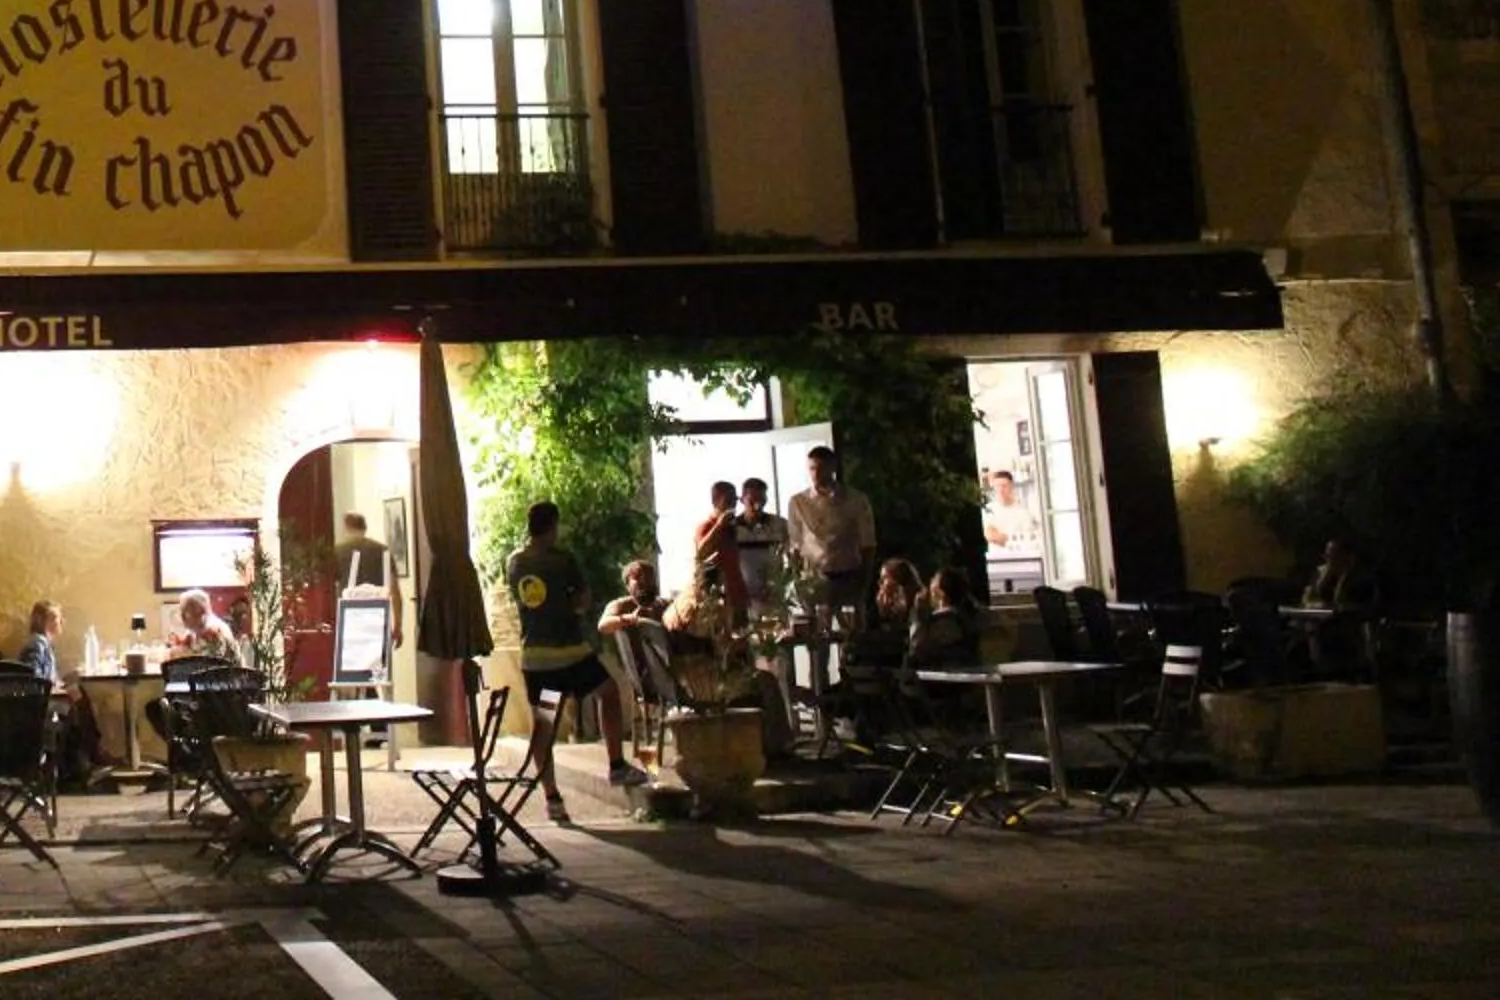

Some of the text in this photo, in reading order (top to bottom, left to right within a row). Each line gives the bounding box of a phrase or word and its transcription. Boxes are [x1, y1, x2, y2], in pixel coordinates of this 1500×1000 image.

[102, 58, 171, 118] du
[105, 103, 315, 220] chapon
[819, 300, 900, 331] BAR
